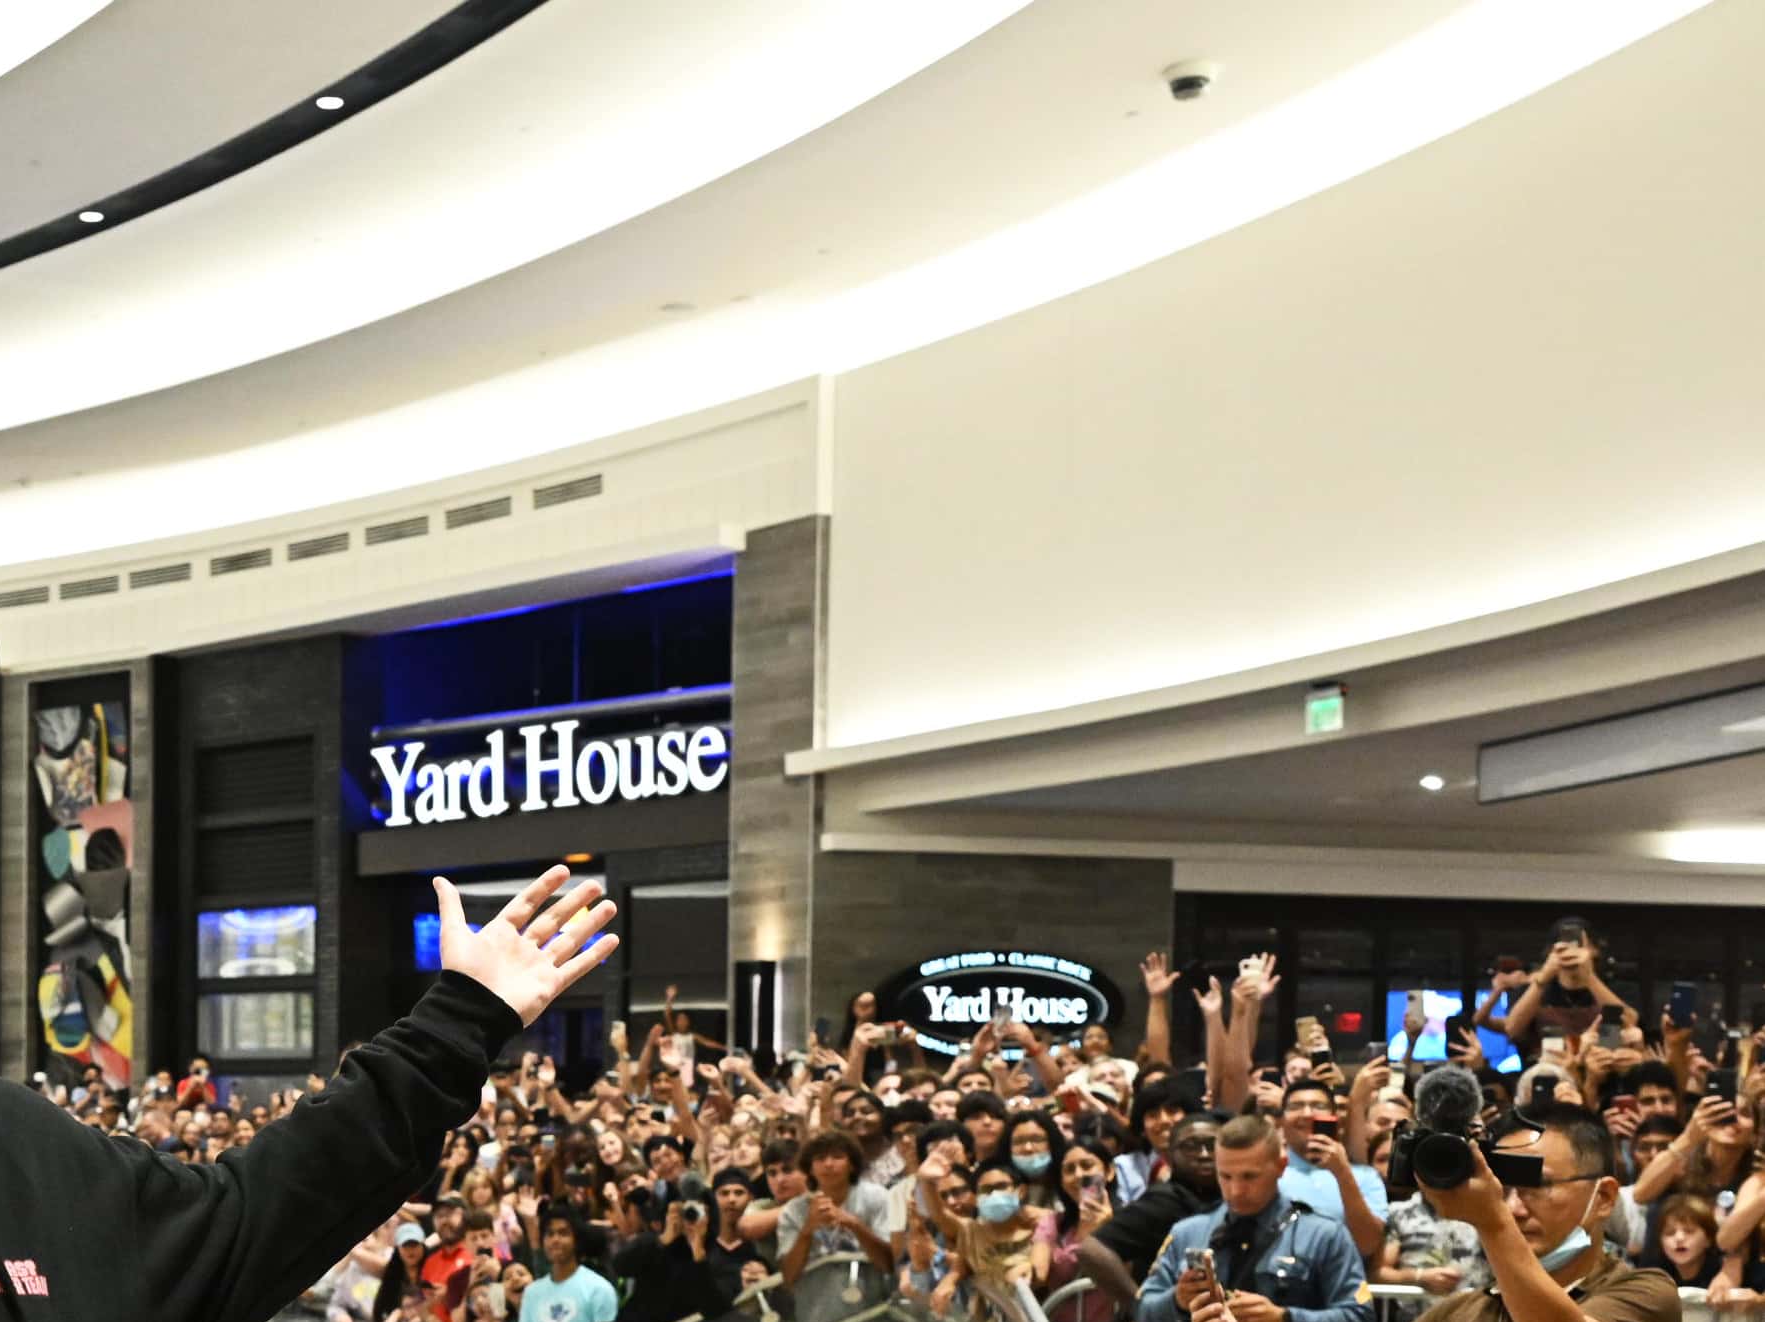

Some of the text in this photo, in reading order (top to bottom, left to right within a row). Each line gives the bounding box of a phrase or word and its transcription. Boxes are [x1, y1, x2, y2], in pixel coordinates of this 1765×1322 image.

[370, 719, 729, 827] Yard House
[922, 985, 1089, 1024] Yard House
